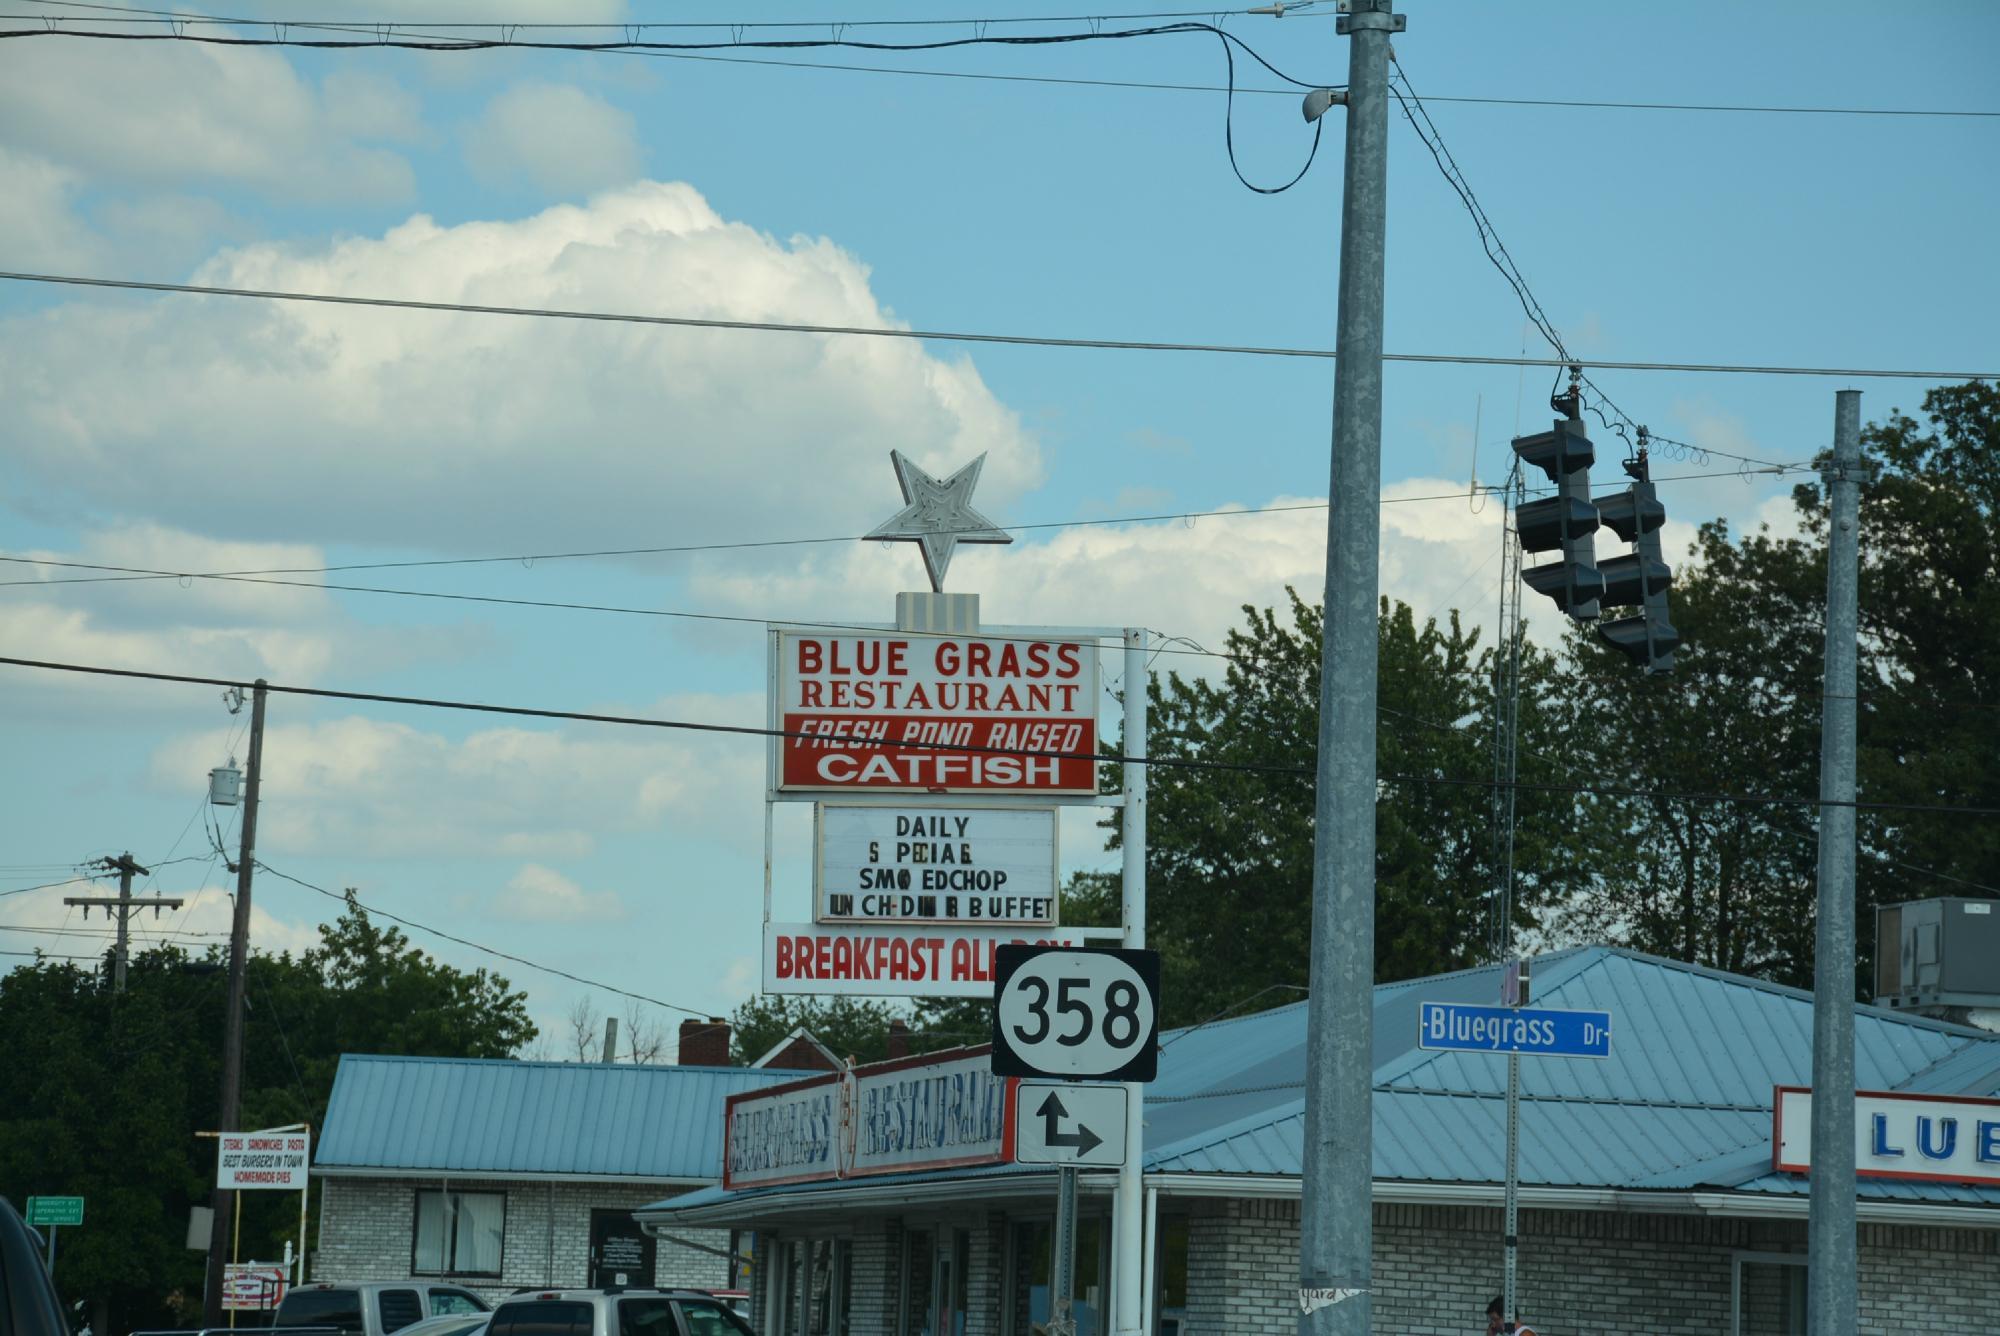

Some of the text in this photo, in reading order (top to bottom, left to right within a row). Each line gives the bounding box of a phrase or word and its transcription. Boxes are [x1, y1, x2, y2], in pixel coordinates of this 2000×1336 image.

[799, 640, 1080, 679] BLUE GRASS
[798, 680, 1080, 712] RESTAURANT
[795, 720, 1083, 753] FRESH POND RAISED
[816, 753, 1061, 785] CATFISH
[897, 816, 970, 837] DAILY
[969, 896, 1054, 918] BUFFET
[776, 936, 945, 981] BREAKFAST
[1013, 975, 1140, 1049] 358
[1431, 1007, 1604, 1050] Bluegrass Dr
[223, 1154, 304, 1168] BEST BURGERS IN TOWN
[224, 1139, 243, 1150] STEAKS
[248, 1139, 283, 1151] SANDWICHES
[234, 1171, 291, 1183] HOMEMADE PIES
